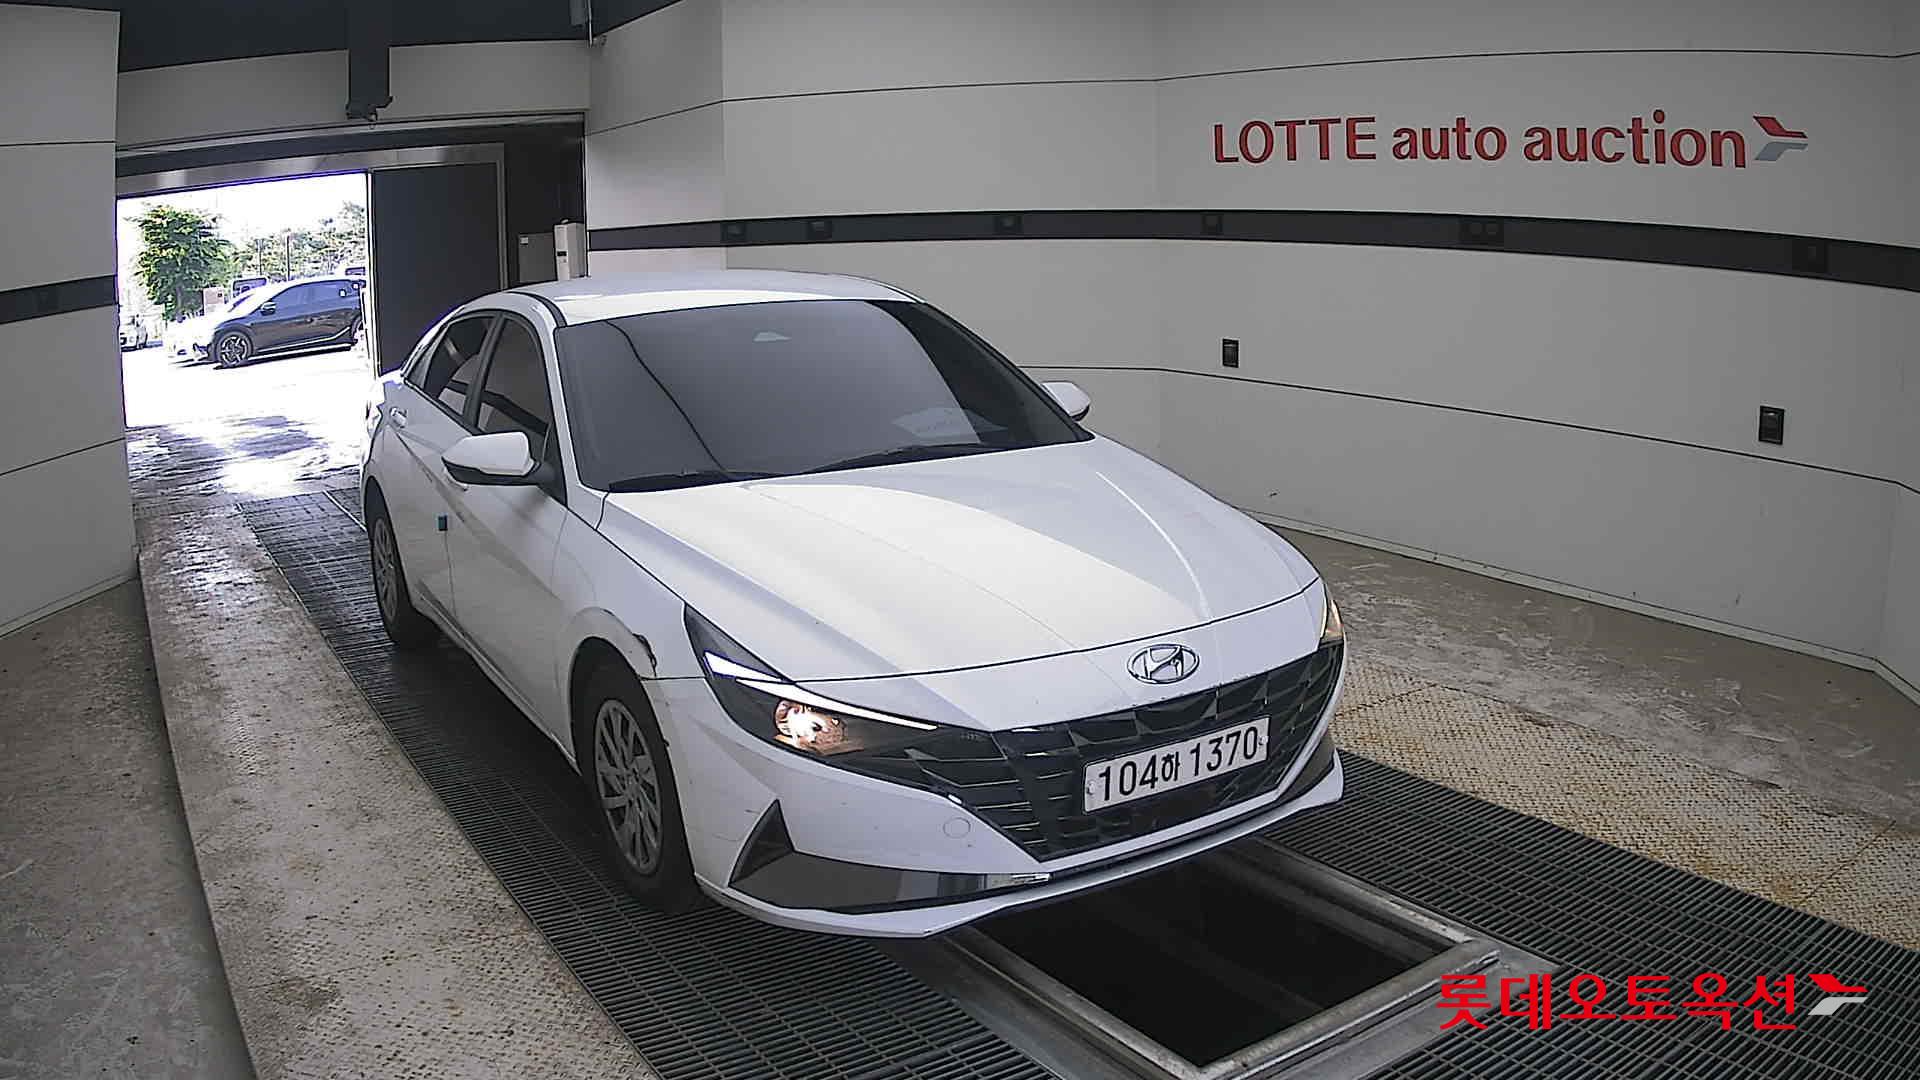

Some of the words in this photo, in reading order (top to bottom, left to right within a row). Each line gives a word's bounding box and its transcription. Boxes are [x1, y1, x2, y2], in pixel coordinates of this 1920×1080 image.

[1213, 116, 1377, 164] LOTTE
[1392, 116, 1508, 162] auto
[1523, 109, 1747, 169] auction
[1099, 752, 1180, 801] 104하
[1190, 726, 1258, 776] 1370
